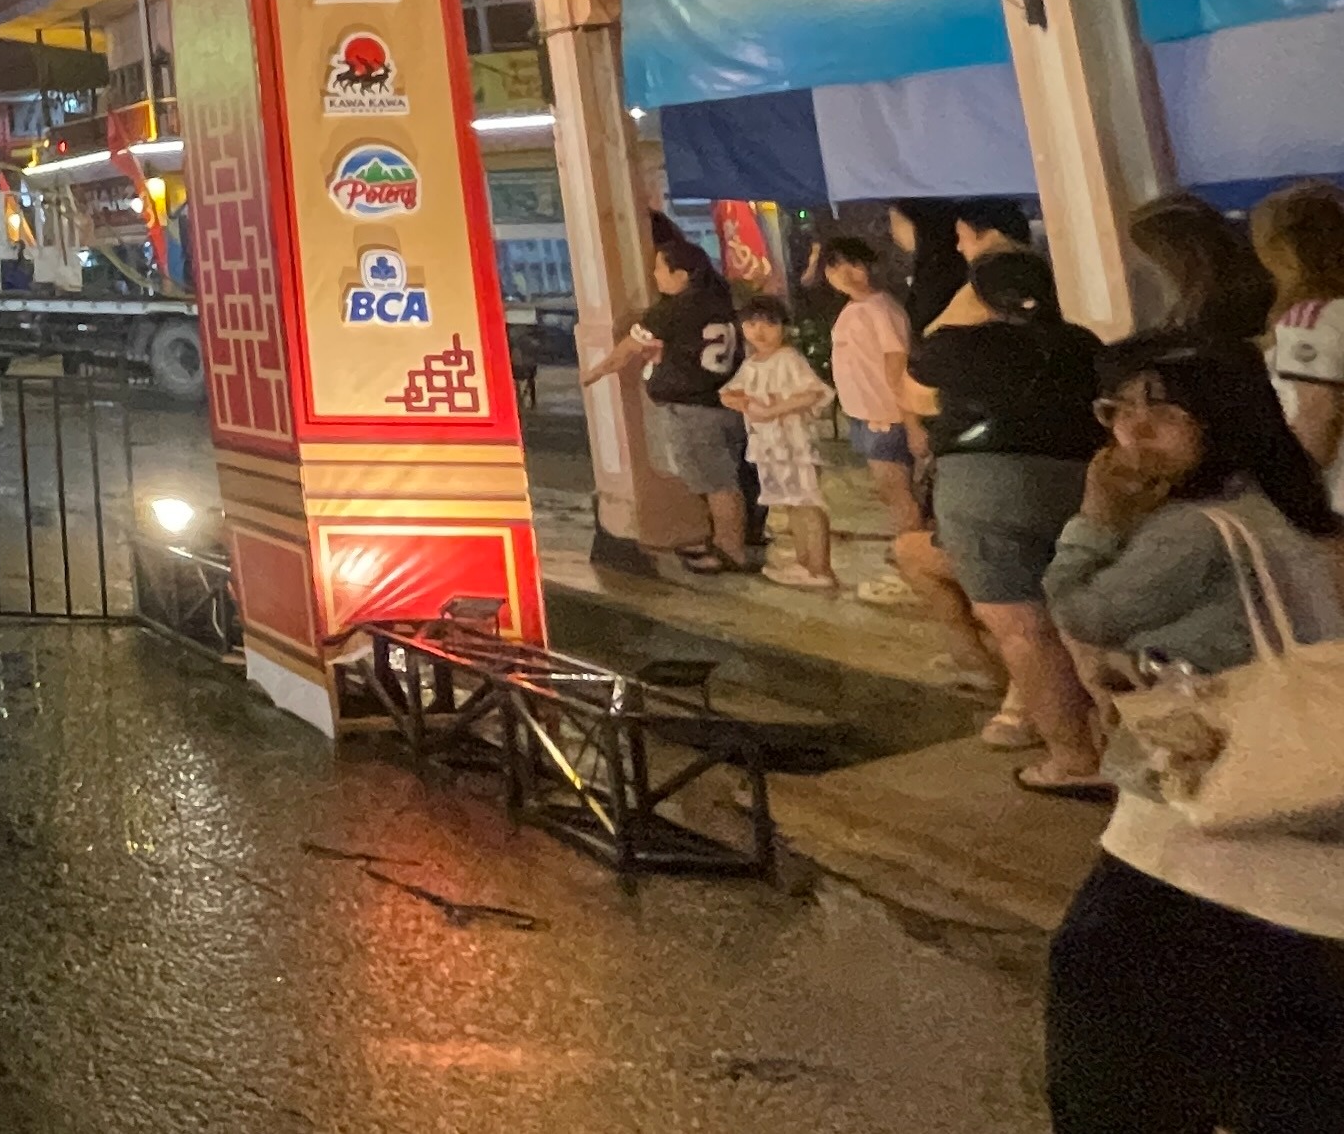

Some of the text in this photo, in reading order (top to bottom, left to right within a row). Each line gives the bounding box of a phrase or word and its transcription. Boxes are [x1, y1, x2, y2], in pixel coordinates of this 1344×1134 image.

[329, 99, 407, 108] KAWA KAWA
[349, 291, 430, 322] BCA
